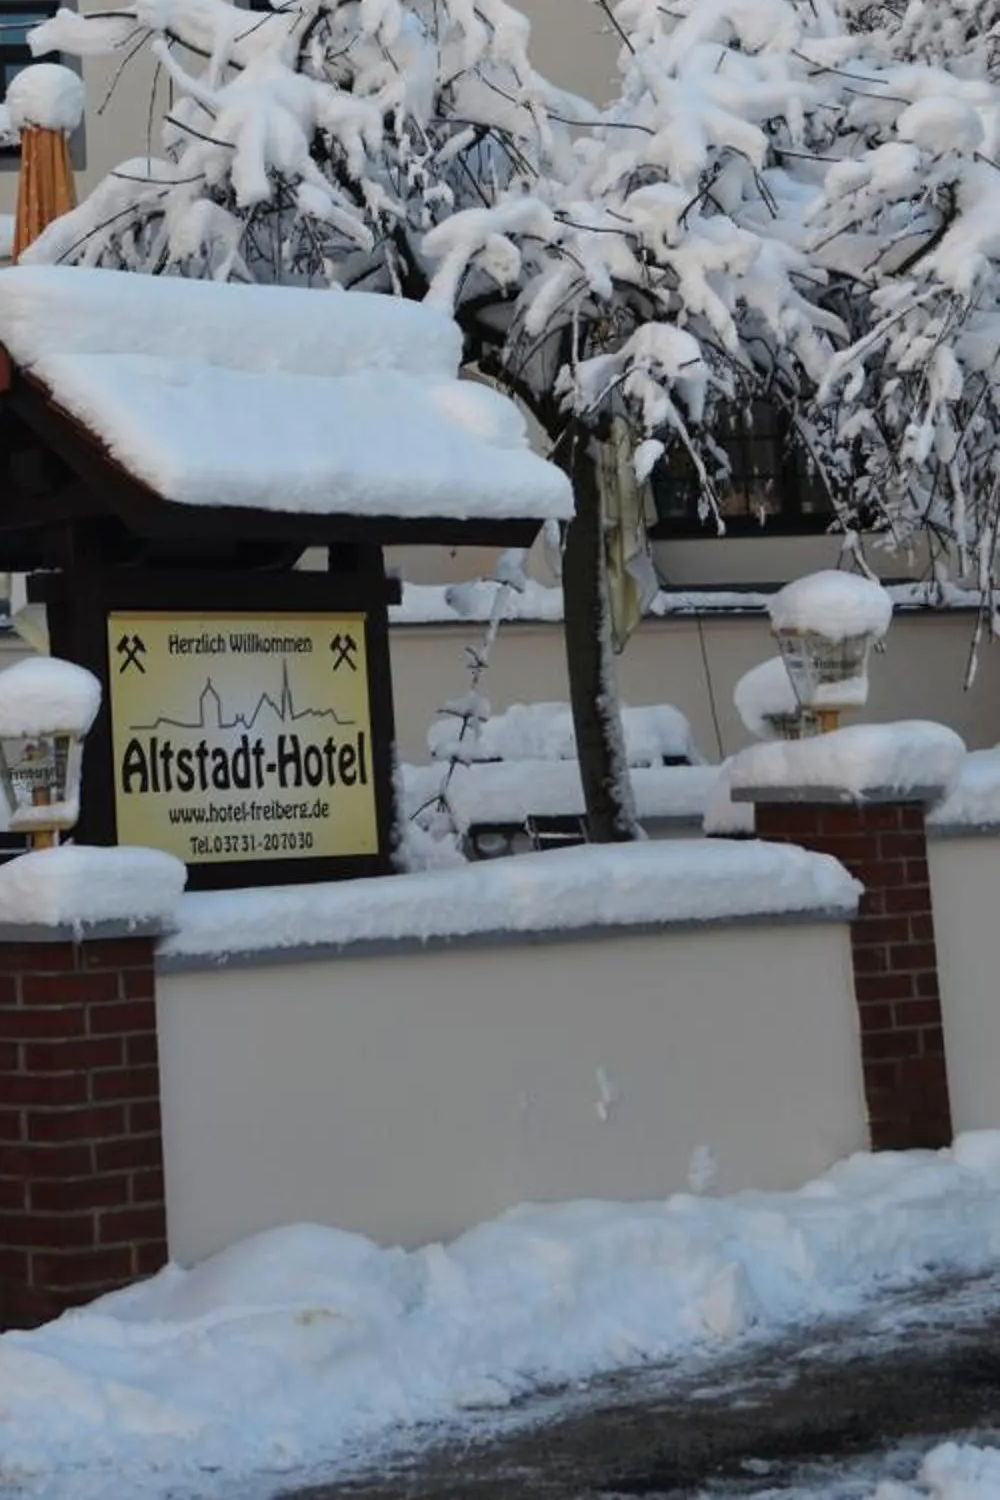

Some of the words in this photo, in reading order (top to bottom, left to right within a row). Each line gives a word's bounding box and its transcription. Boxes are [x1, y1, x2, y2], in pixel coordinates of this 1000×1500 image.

[168, 634, 226, 654] Herzlich
[228, 633, 313, 653] Willkommen
[121, 732, 368, 794] Altstadt-Hotel
[169, 798, 330, 825] www.hotel-freiberg.de
